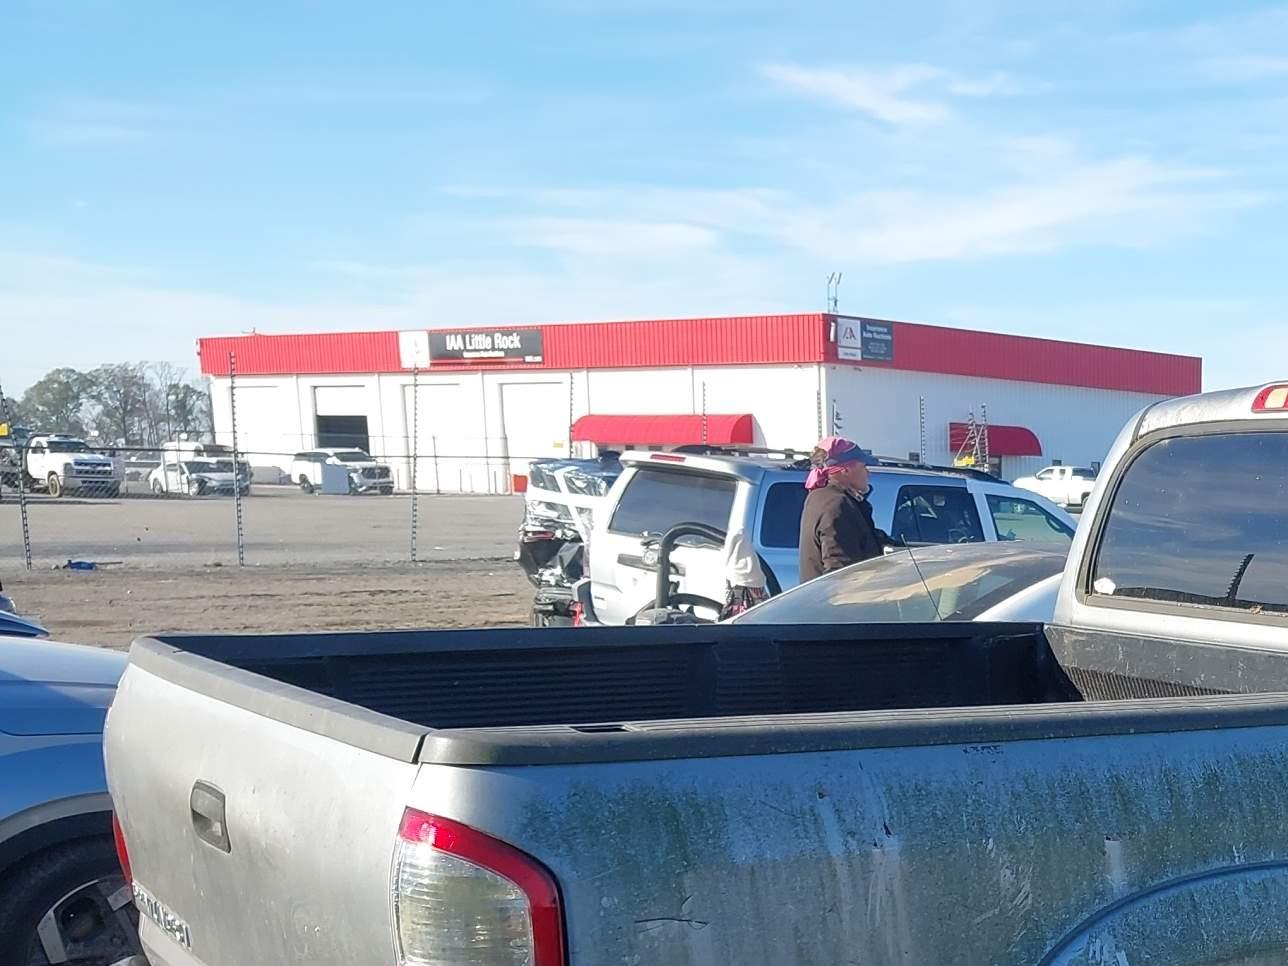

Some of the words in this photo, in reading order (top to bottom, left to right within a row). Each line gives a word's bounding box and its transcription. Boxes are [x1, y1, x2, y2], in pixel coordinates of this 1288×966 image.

[445, 334, 464, 351] IAA
[465, 333, 492, 350] Little
[494, 332, 522, 349] Rock
